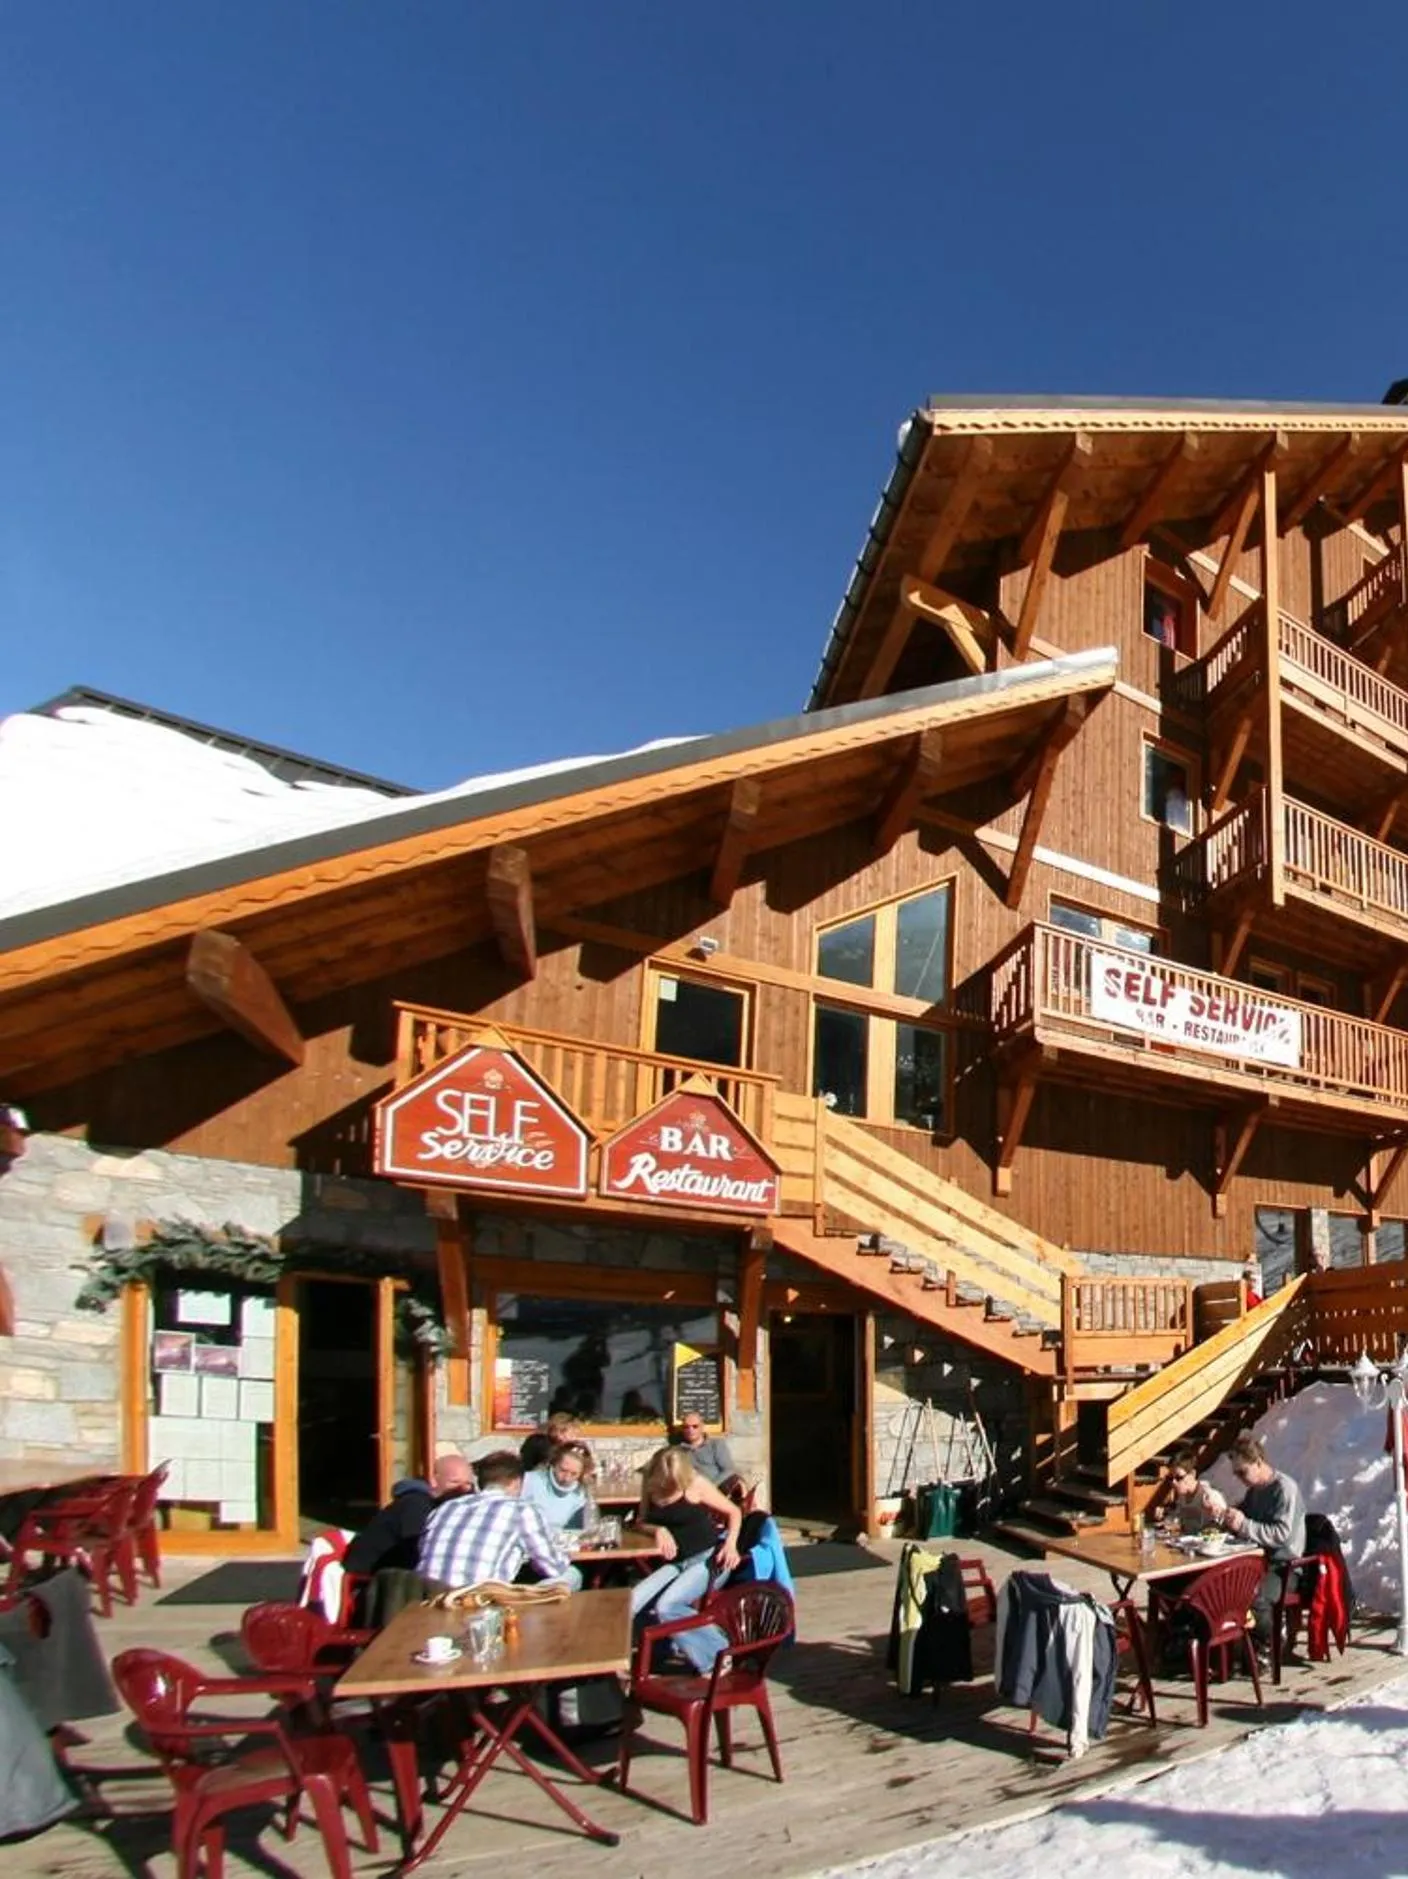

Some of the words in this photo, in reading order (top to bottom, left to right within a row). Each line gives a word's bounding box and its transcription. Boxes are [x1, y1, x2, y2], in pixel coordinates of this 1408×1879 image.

[1104, 967, 1176, 1009] SELF
[435, 1088, 541, 1145] SELF
[416, 1131, 555, 1170] Service
[659, 1126, 734, 1161] BAR
[612, 1151, 774, 1203] Restaurant
